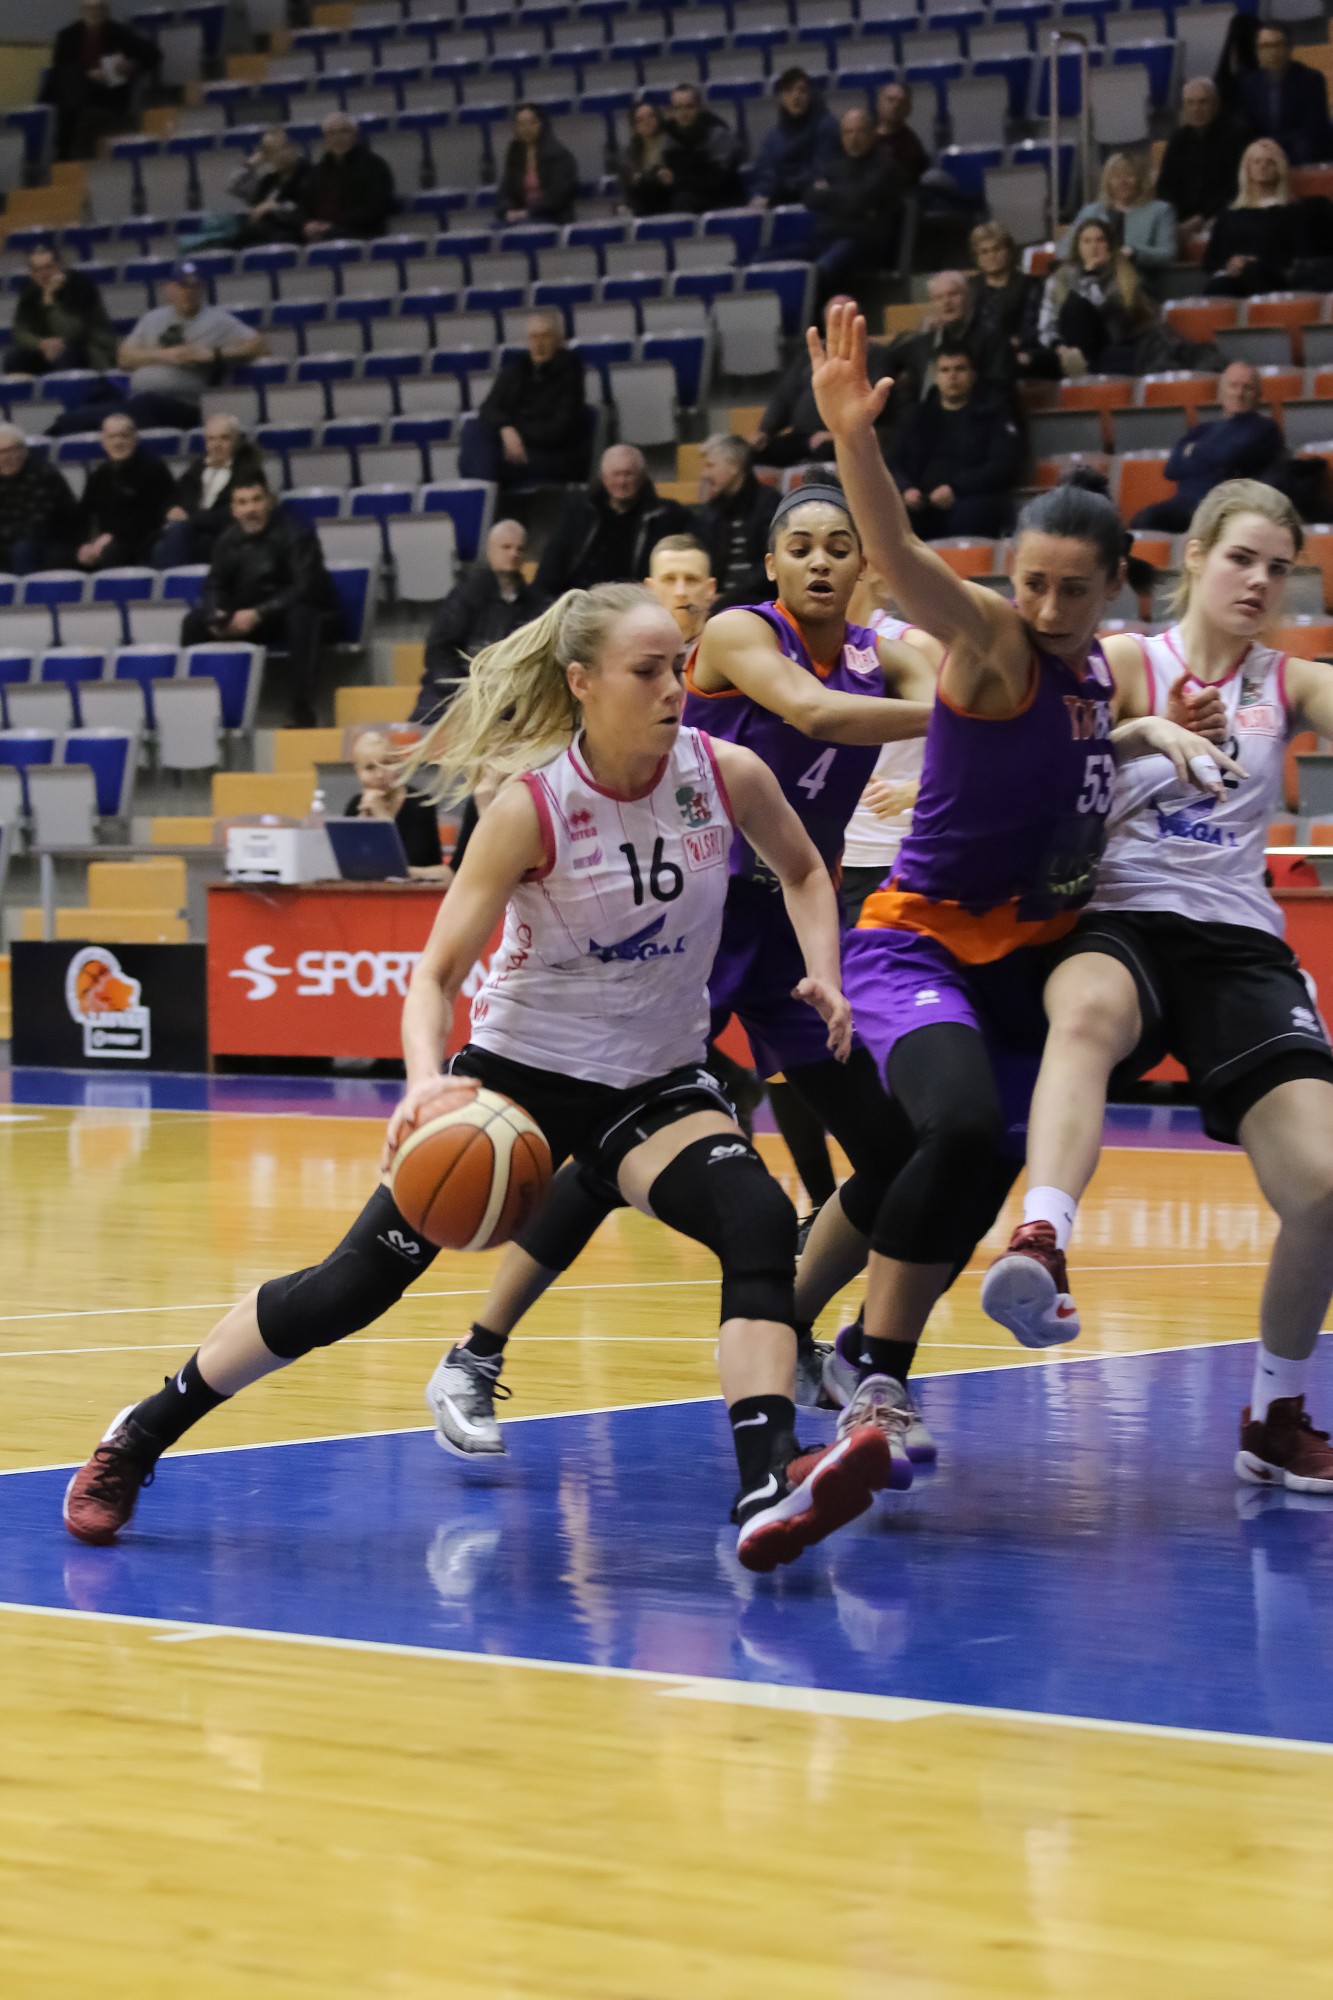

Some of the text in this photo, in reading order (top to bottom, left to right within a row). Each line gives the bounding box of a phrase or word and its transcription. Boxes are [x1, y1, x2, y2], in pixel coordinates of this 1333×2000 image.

[797, 747, 838, 800] 4
[1076, 754, 1117, 814] 53
[619, 836, 684, 906] 16
